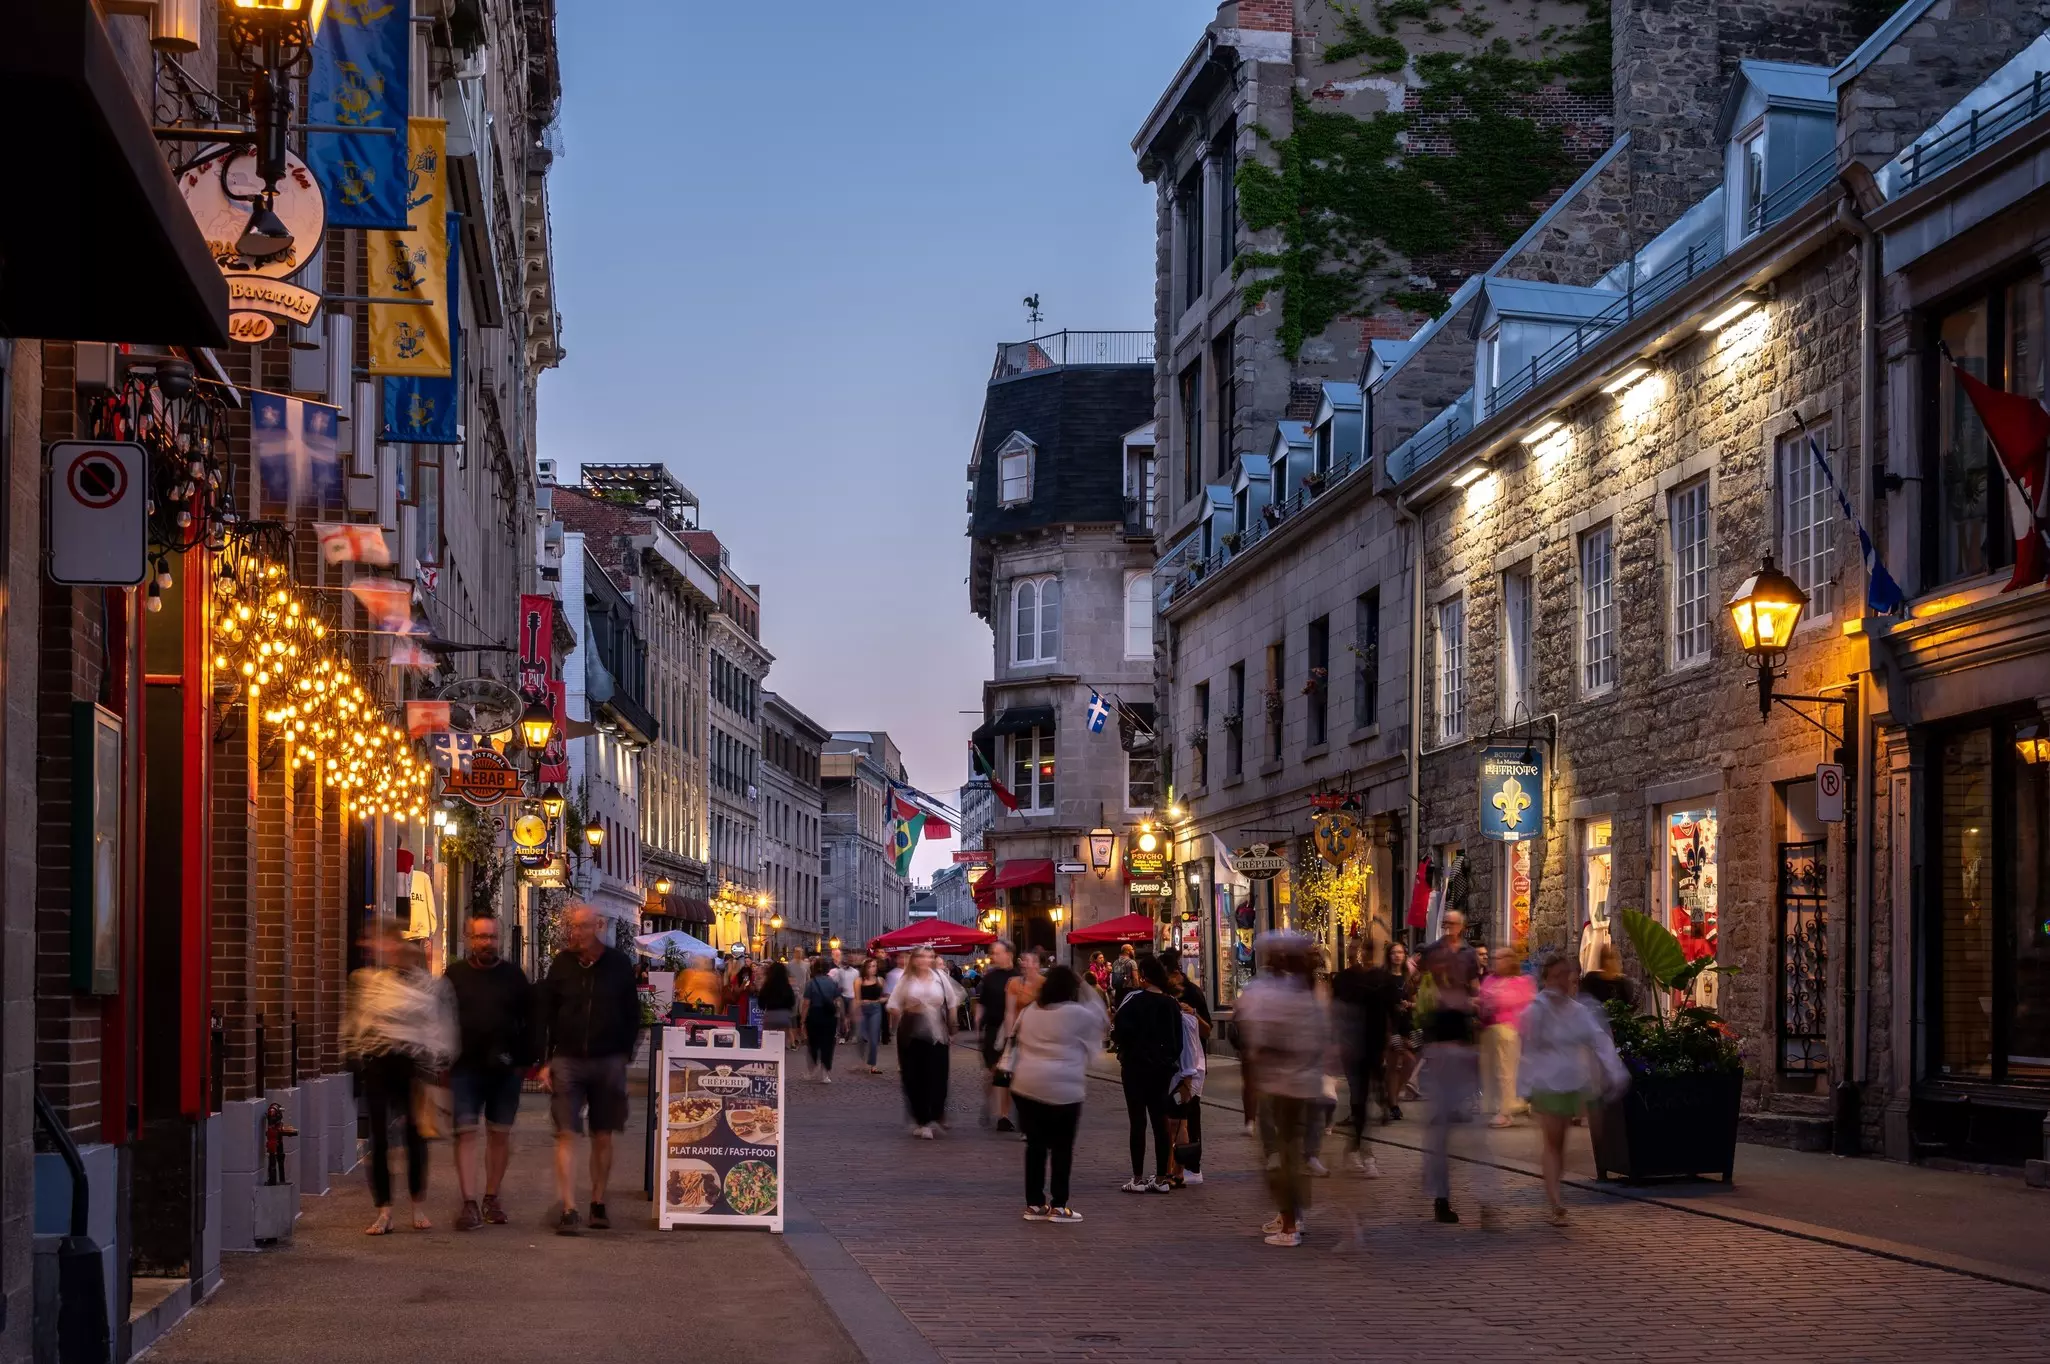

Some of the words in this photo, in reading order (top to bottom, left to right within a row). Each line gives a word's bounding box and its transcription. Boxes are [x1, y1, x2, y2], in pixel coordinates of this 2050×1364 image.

[231, 283, 311, 314] Bavarois
[229, 318, 268, 338] 140
[472, 751, 505, 769] ONTREAL
[462, 771, 505, 786] KEBAB
[515, 845, 545, 855] Amber
[523, 868, 560, 876] ARTISANS
[1130, 882, 1160, 893] Espresso
[701, 1077, 746, 1086] CRÊPERIE
[669, 1146, 691, 1155] PLAT
[692, 1146, 723, 1156] RAPIDE
[724, 1147, 729, 1156] /
[729, 1147, 776, 1158] FAST-FOOD
